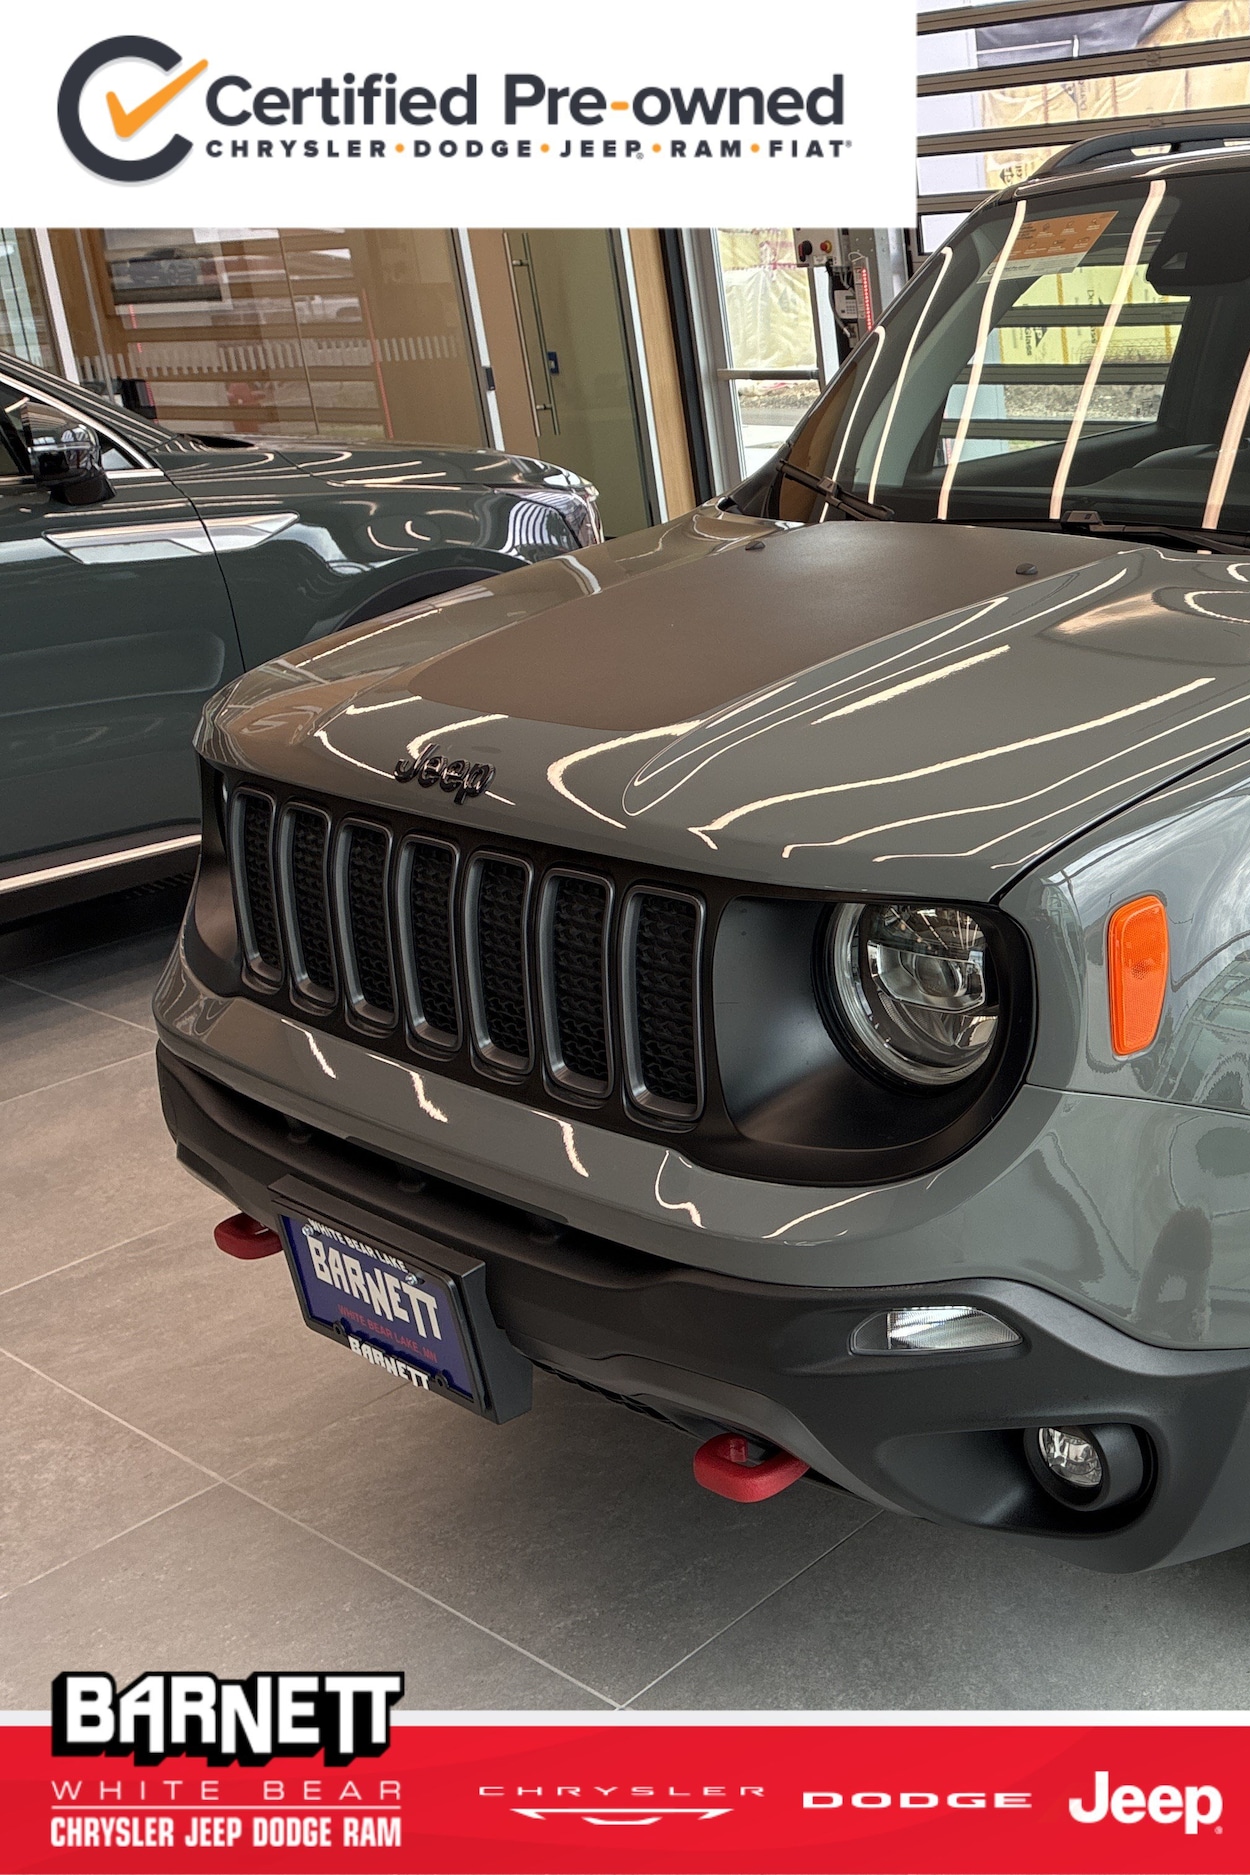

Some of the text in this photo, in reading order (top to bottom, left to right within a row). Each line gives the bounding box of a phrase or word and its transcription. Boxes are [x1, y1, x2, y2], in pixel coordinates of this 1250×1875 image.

[394, 743, 496, 805] Jeep
[307, 1218, 409, 1274] WHITE BEAR LAKE
[307, 1234, 442, 1341] BARNETT
[337, 1304, 367, 1327] WHITE
[366, 1318, 394, 1340] BEAR
[422, 1346, 438, 1364] MN
[348, 1336, 430, 1391] BARNETT
